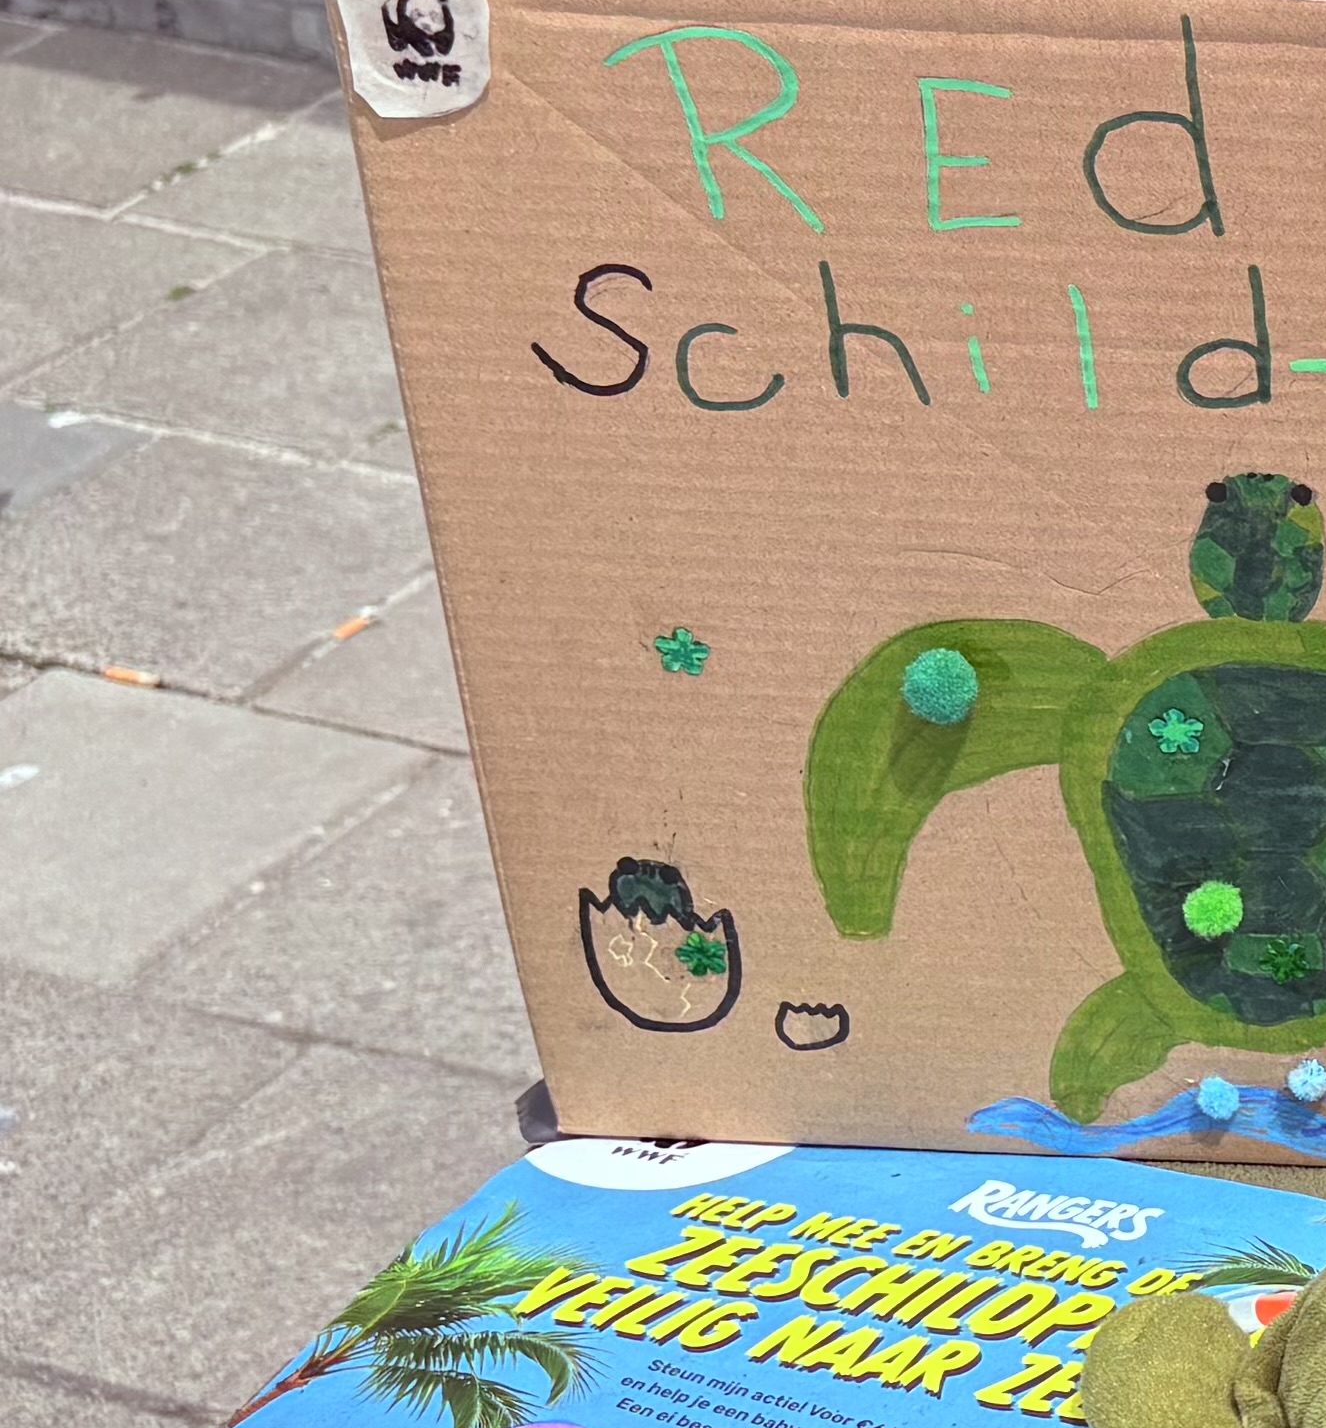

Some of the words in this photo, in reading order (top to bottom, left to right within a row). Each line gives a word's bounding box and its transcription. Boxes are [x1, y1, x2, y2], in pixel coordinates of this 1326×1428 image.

[611, 1146, 687, 1164] WWF
[670, 1193, 797, 1233] HELP
[789, 1212, 902, 1250] MEE
[892, 1229, 972, 1261] EN
[964, 1240, 1128, 1290] BRENG
[948, 1180, 1165, 1249] RANGERS
[625, 1225, 1116, 1355] ZEESCHILDP
[514, 1266, 758, 1353] VEILIG
[744, 1313, 982, 1400] NAAR
[974, 1353, 1088, 1427] ZE
[616, 1397, 654, 1418] Een
[656, 1411, 678, 1424] ei
[620, 1376, 646, 1391] en
[646, 1382, 690, 1405] help
[687, 1395, 711, 1410] je
[713, 1405, 749, 1422] een
[648, 1358, 705, 1384] Steun
[706, 1377, 749, 1397] mijn
[751, 1391, 809, 1413] actie!
[809, 1404, 855, 1426] Voor
